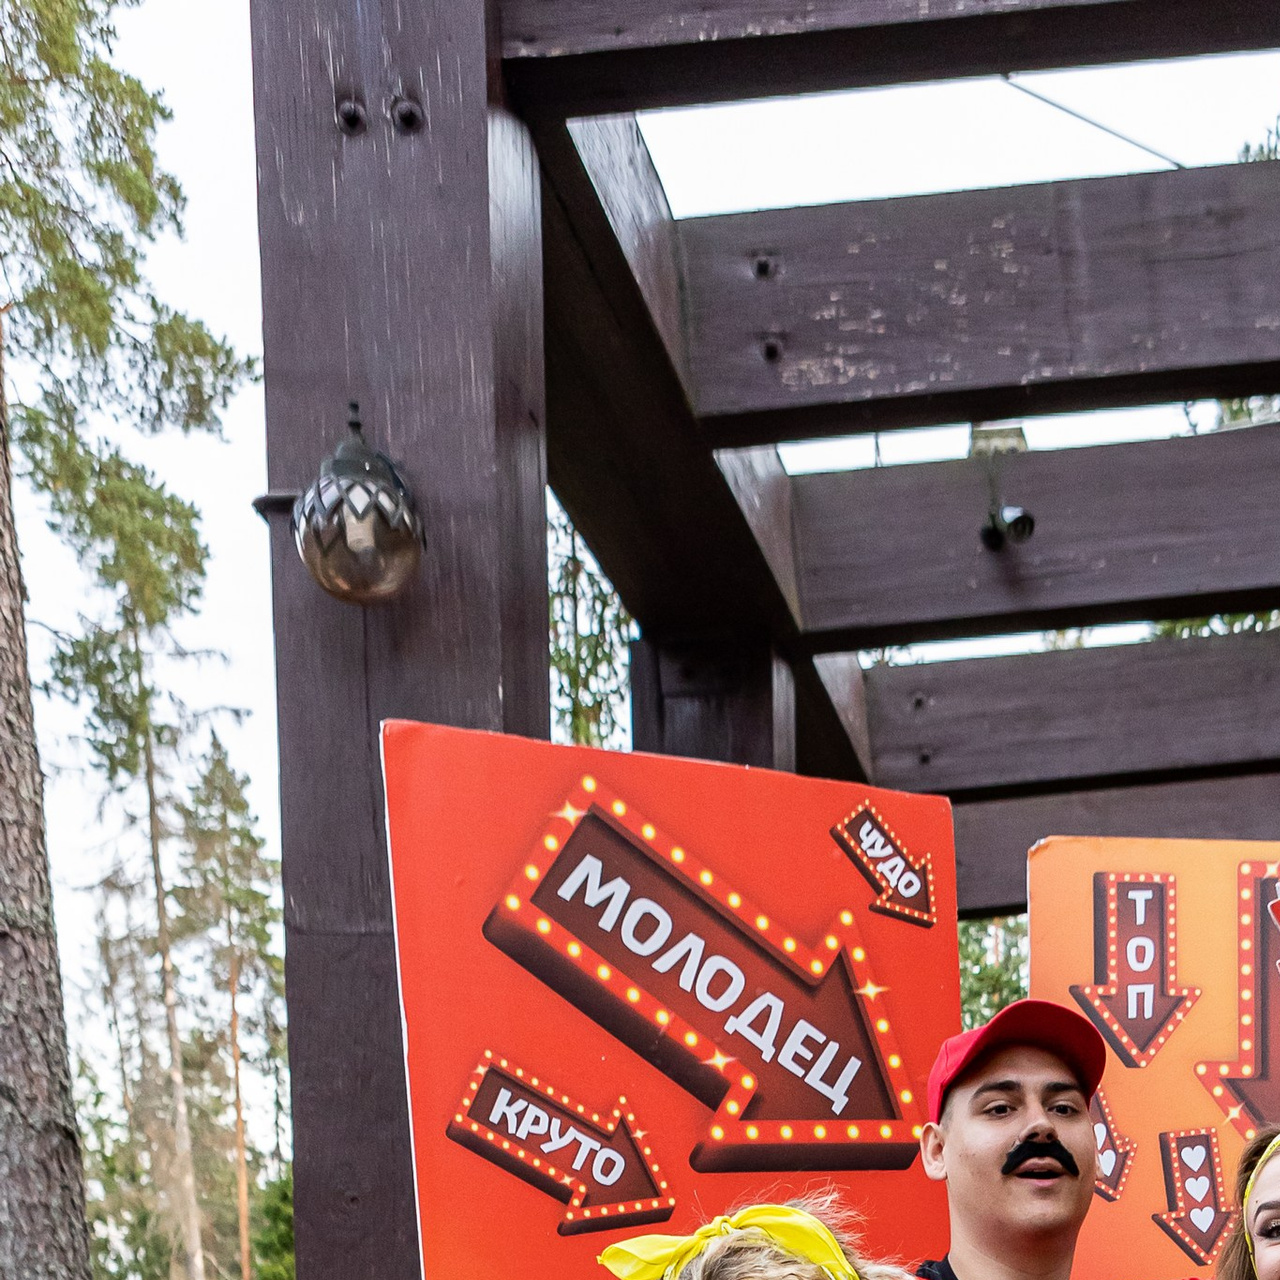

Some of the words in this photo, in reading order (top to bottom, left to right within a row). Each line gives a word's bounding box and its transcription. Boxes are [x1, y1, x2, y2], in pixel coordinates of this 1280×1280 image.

[859, 820, 922, 898] ЧУДО
[557, 853, 863, 1116] МОЛОДЕЦ
[1126, 889, 1155, 1020] ТОП
[488, 1090, 627, 1187] КРУТО
